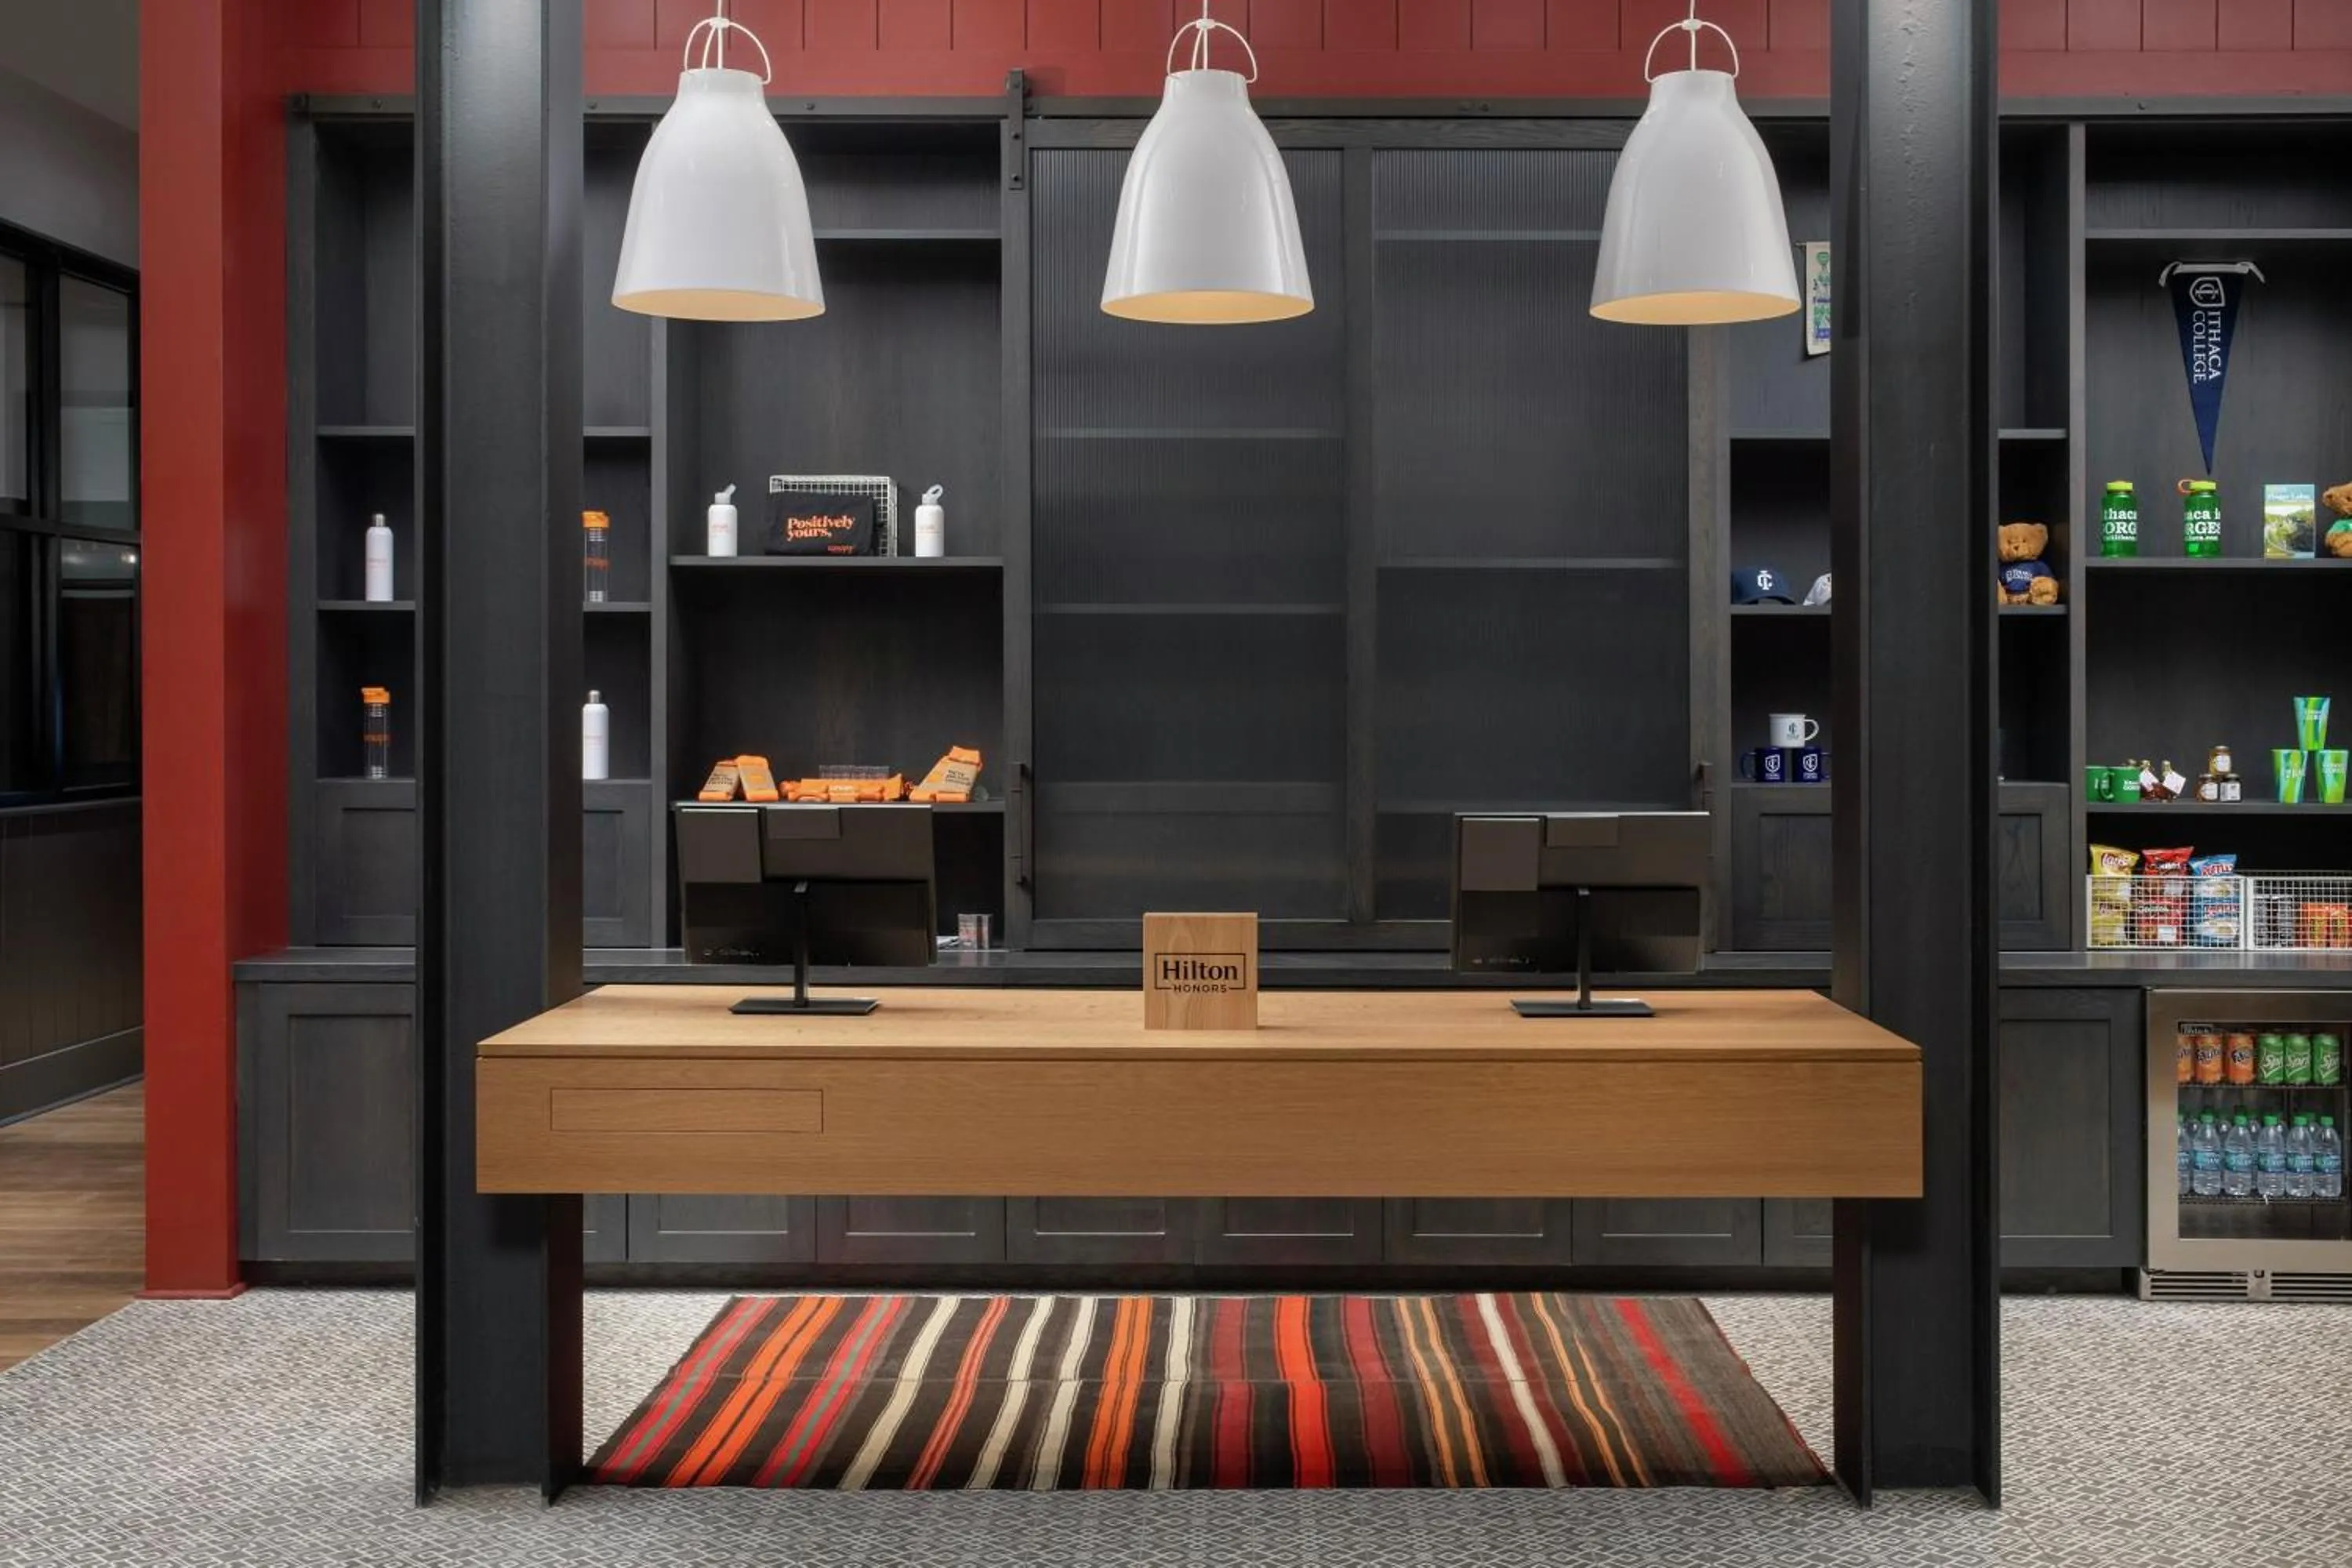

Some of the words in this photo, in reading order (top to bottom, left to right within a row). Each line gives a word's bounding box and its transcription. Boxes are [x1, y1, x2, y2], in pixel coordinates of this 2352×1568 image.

[2192, 310, 2208, 384] COLLEGE
[2207, 311, 2222, 380] ITHACA
[787, 515, 855, 530] Positively
[1163, 960, 1238, 980] Hilton
[1174, 984, 1227, 993] HONORS
